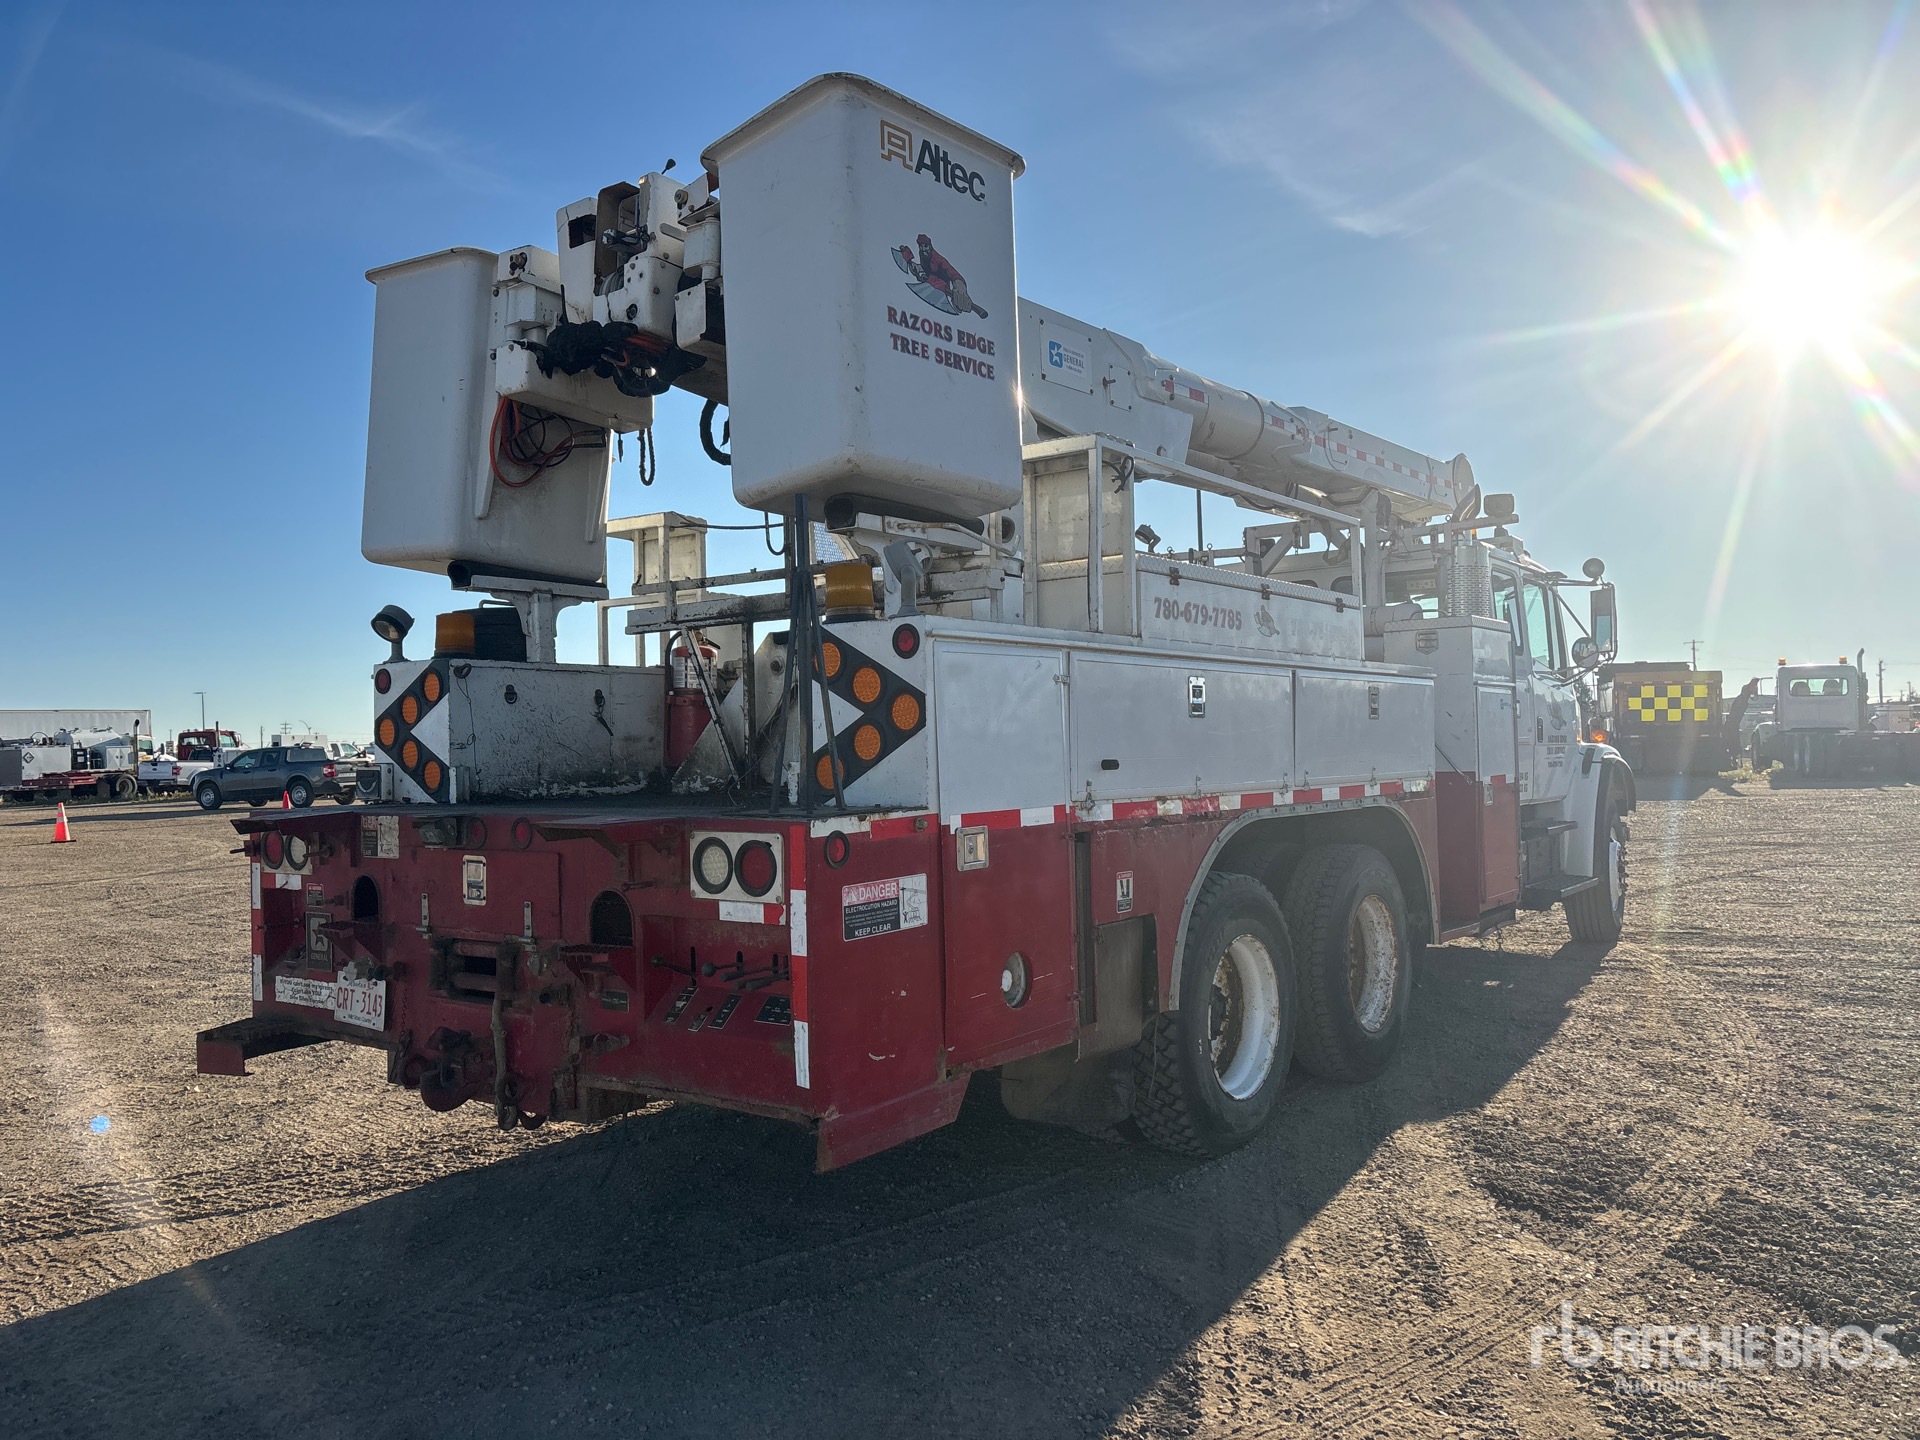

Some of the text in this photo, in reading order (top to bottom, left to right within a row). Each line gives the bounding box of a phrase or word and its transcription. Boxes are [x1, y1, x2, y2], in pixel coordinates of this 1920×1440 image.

[914, 139, 986, 202] Altec
[887, 305, 996, 356] RAZORS EDGE
[890, 332, 996, 381] TREE SERVICE
[1063, 353, 1084, 369] GENERAL
[1154, 596, 1242, 630] 780-679-7785
[859, 882, 898, 901] DANGER
[881, 899, 898, 908] HAZARD
[854, 923, 891, 937] KEEP CLEAR
[310, 952, 328, 962] GENERAL
